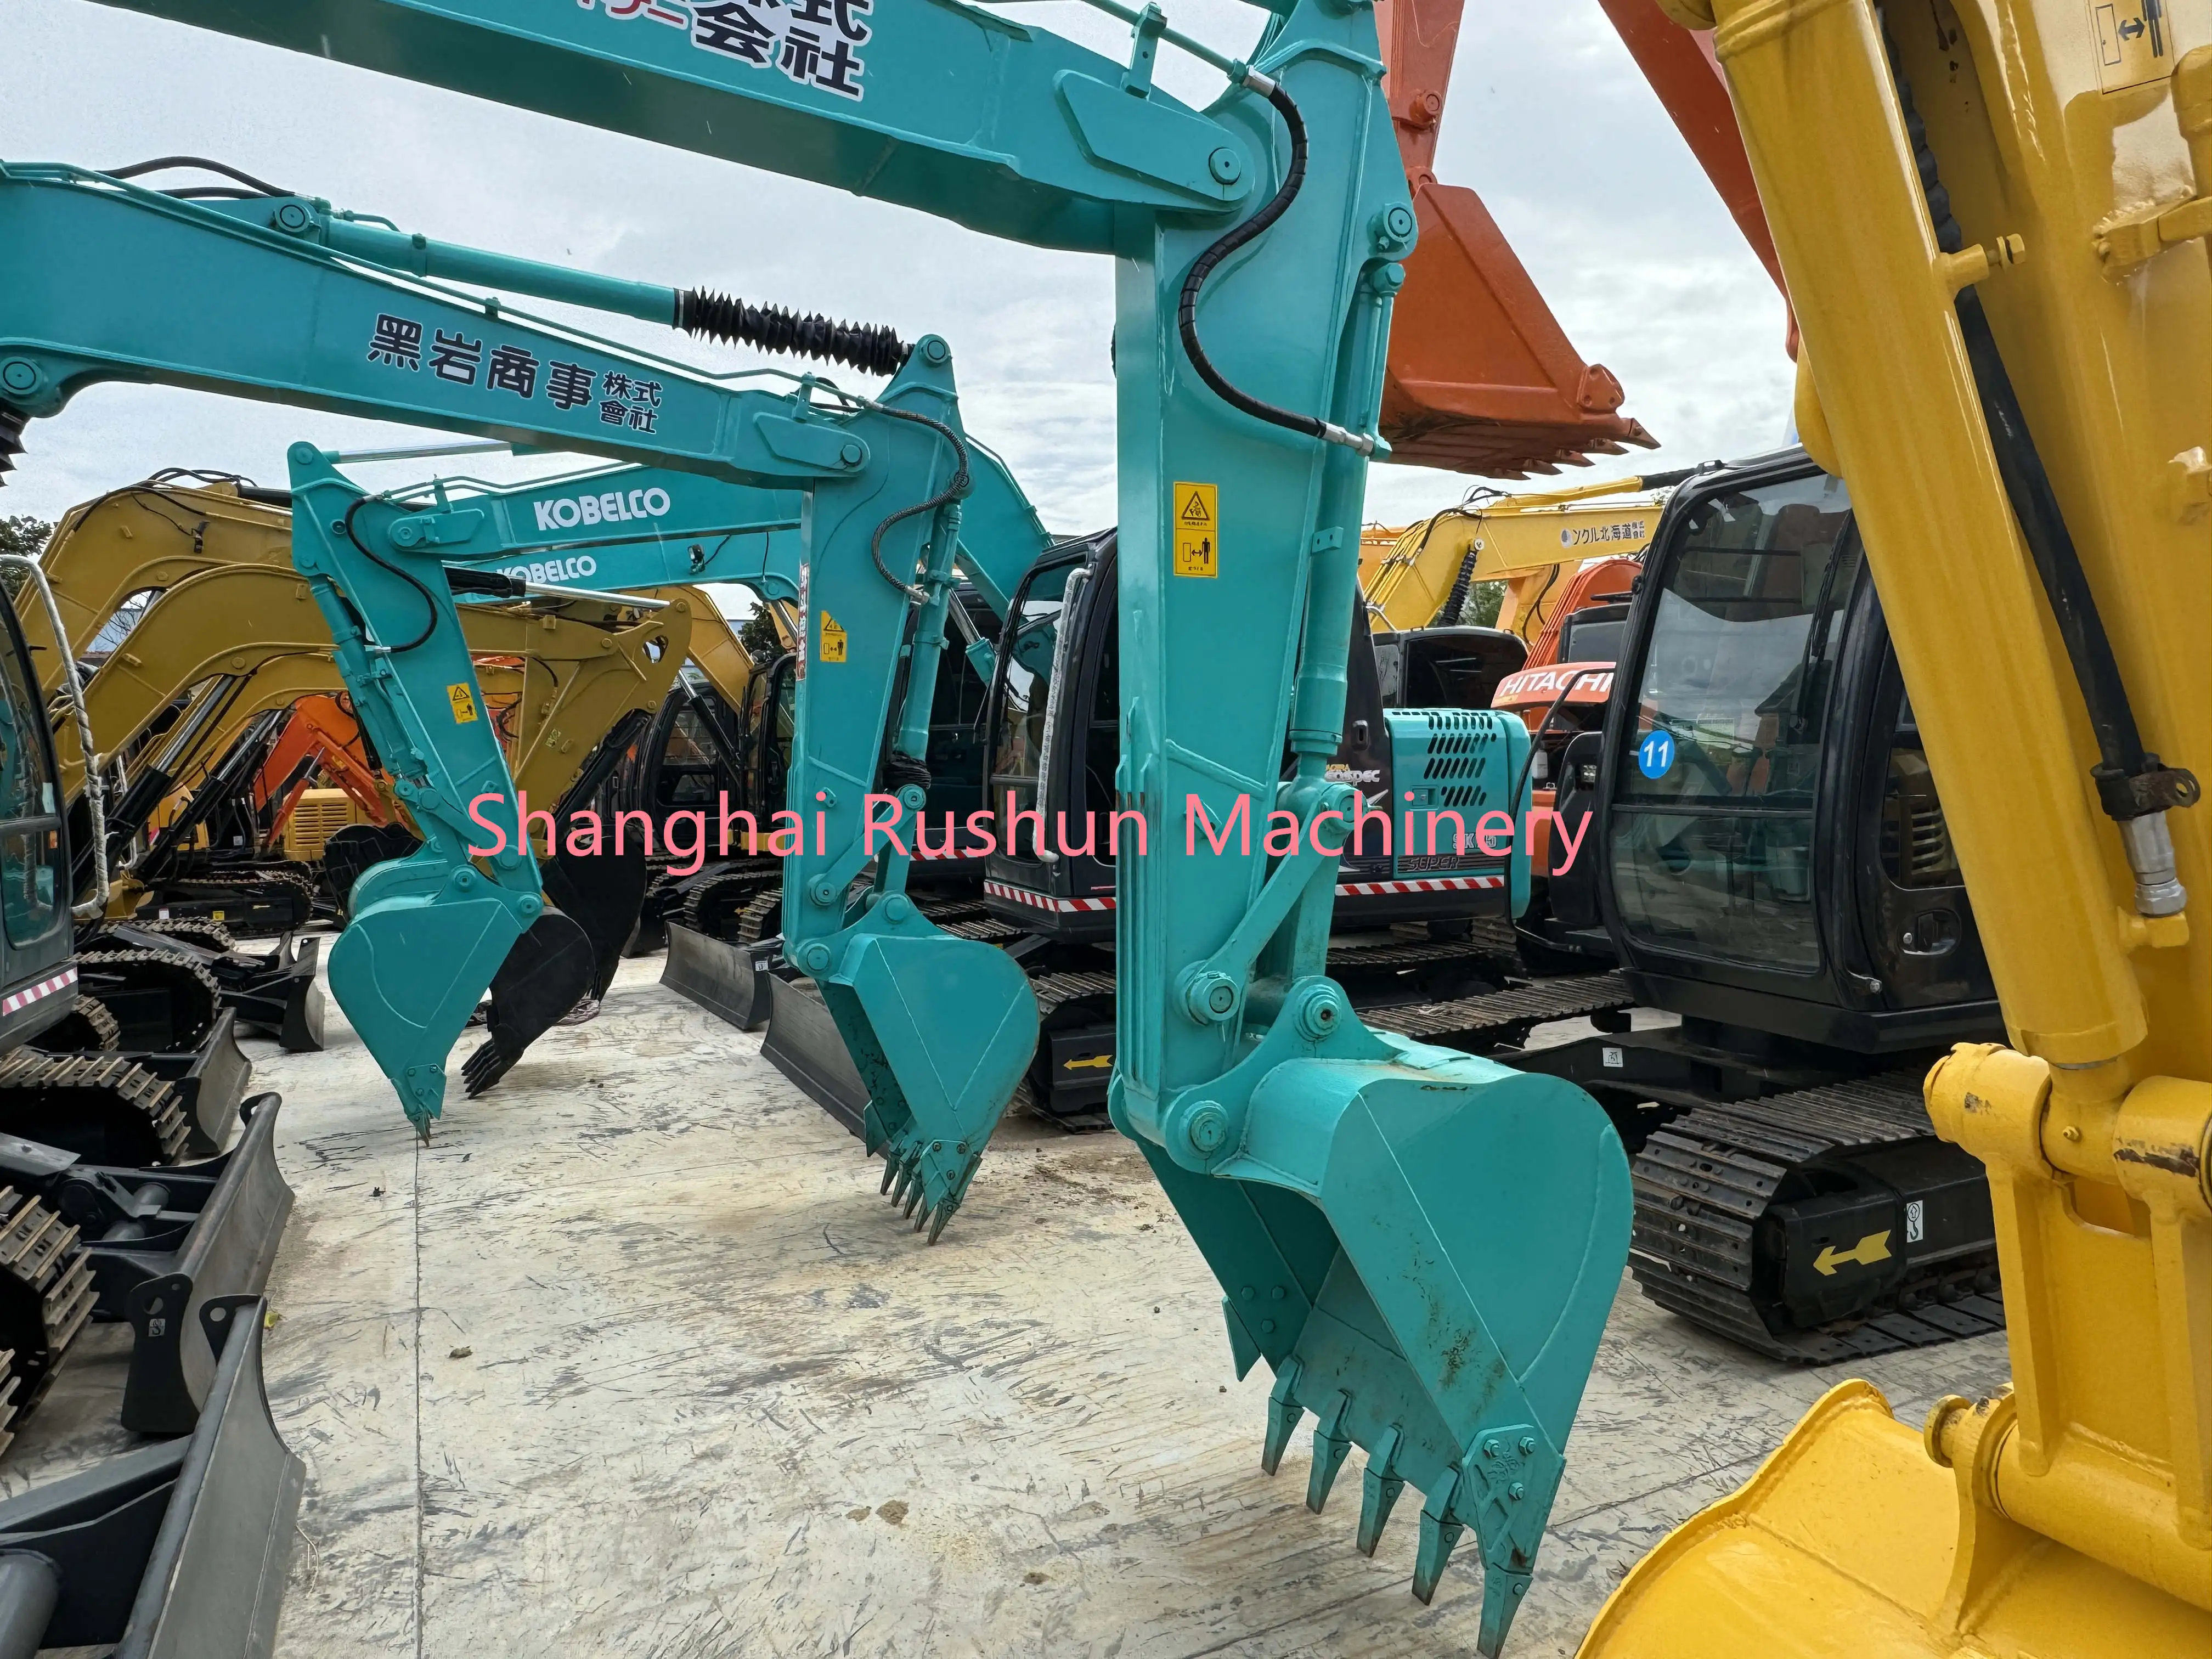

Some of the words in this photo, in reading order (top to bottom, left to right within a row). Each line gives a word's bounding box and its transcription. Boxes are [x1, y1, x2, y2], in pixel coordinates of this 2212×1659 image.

[692, 2, 861, 98] 会社
[602, 370, 663, 408] 株式
[599, 399, 658, 434] 會社
[533, 487, 670, 531] KOBELCO
[1499, 670, 1614, 697] HITACHI
[1644, 740, 1668, 768] 11
[1406, 856, 1460, 871] SUPER
